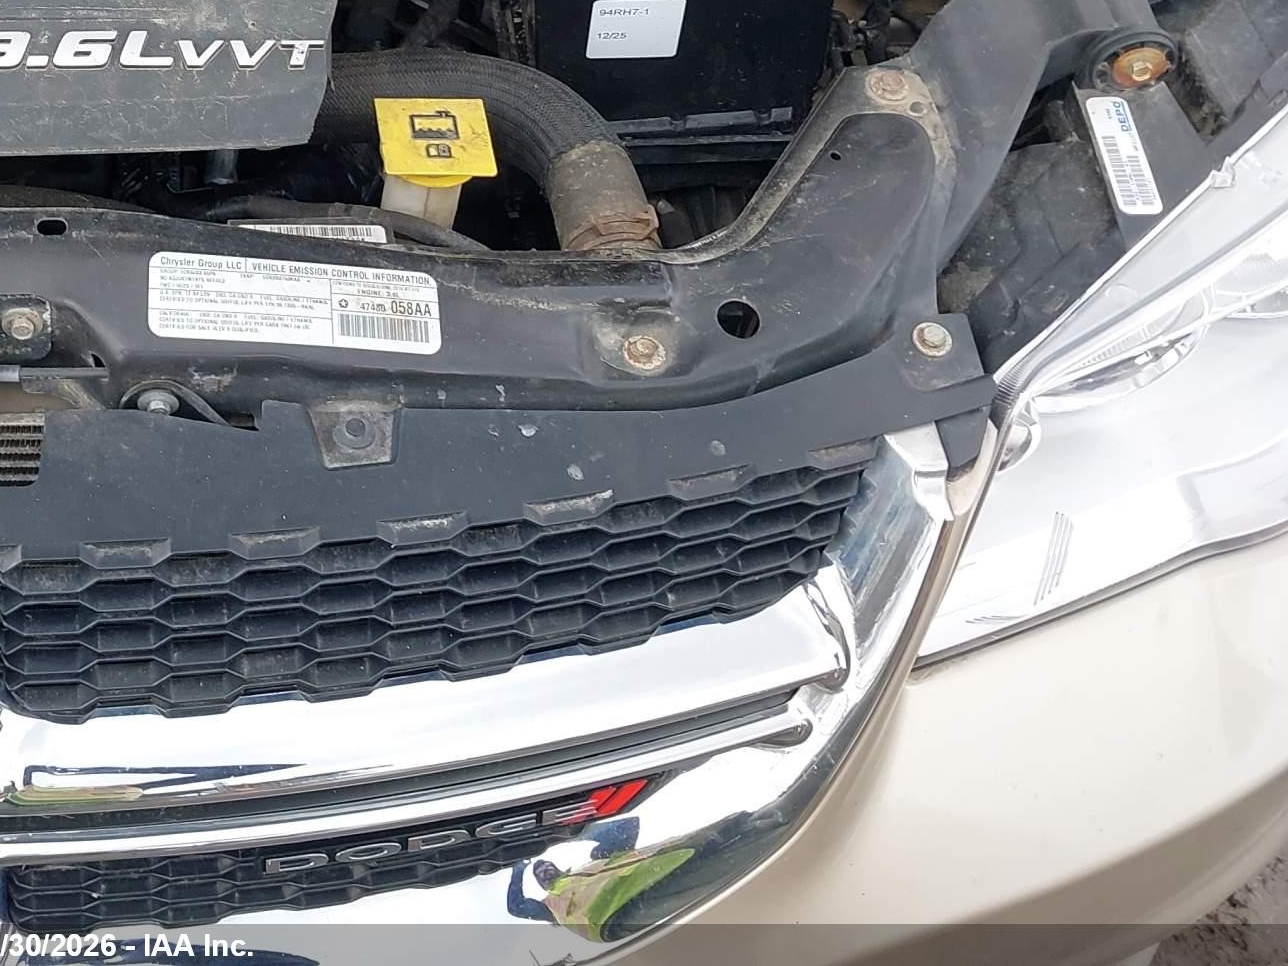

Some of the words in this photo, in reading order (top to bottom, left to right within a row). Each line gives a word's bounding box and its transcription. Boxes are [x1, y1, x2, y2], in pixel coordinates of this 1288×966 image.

[599, 8, 649, 16] 94RH7-1
[597, 32, 627, 40] 12/25
[177, 40, 325, 70] VVT
[1112, 101, 1129, 132] DEPO
[160, 256, 194, 267] Chrysler
[198, 258, 222, 269] Group
[226, 260, 242, 270] LLC
[252, 262, 285, 272] VEHICLE
[289, 264, 328, 276] EMISSION
[332, 269, 369, 280] CONTROL
[391, 301, 432, 316] 058AA
[264, 800, 597, 875] DODGE
